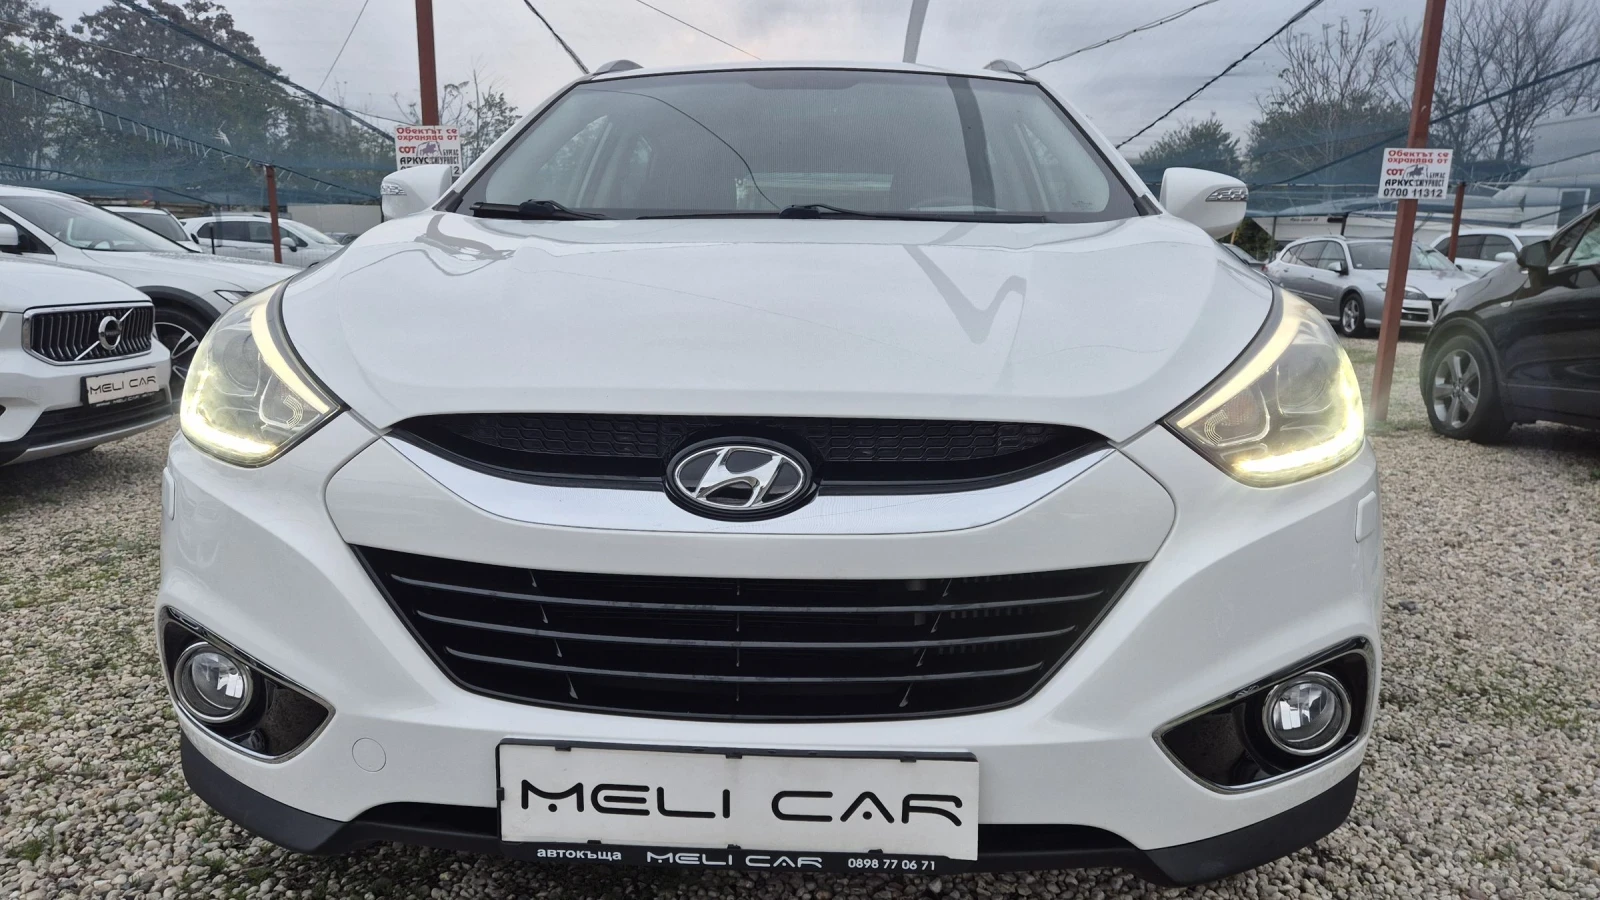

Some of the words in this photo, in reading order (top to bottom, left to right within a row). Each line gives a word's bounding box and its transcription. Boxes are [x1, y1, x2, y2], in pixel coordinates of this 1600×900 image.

[396, 127, 442, 135] Обектът
[398, 146, 417, 154] СОТ
[400, 157, 429, 165] АРКУС
[1386, 168, 1404, 176] СОТ
[1385, 179, 1414, 187] АРКУС
[1383, 188, 1408, 197] 0700
[1412, 188, 1443, 197] 11312
[90, 380, 124, 395] MELI
[129, 376, 156, 388] CAR
[521, 779, 730, 819] MELI
[771, 790, 963, 827] CAR
[536, 849, 622, 862] автокъща
[646, 851, 733, 866] MELI
[745, 855, 823, 869] CAR
[847, 858, 879, 869] 0898
[883, 859, 898, 870] 77
[901, 859, 918, 870] 06
[921, 860, 935, 871] 71
